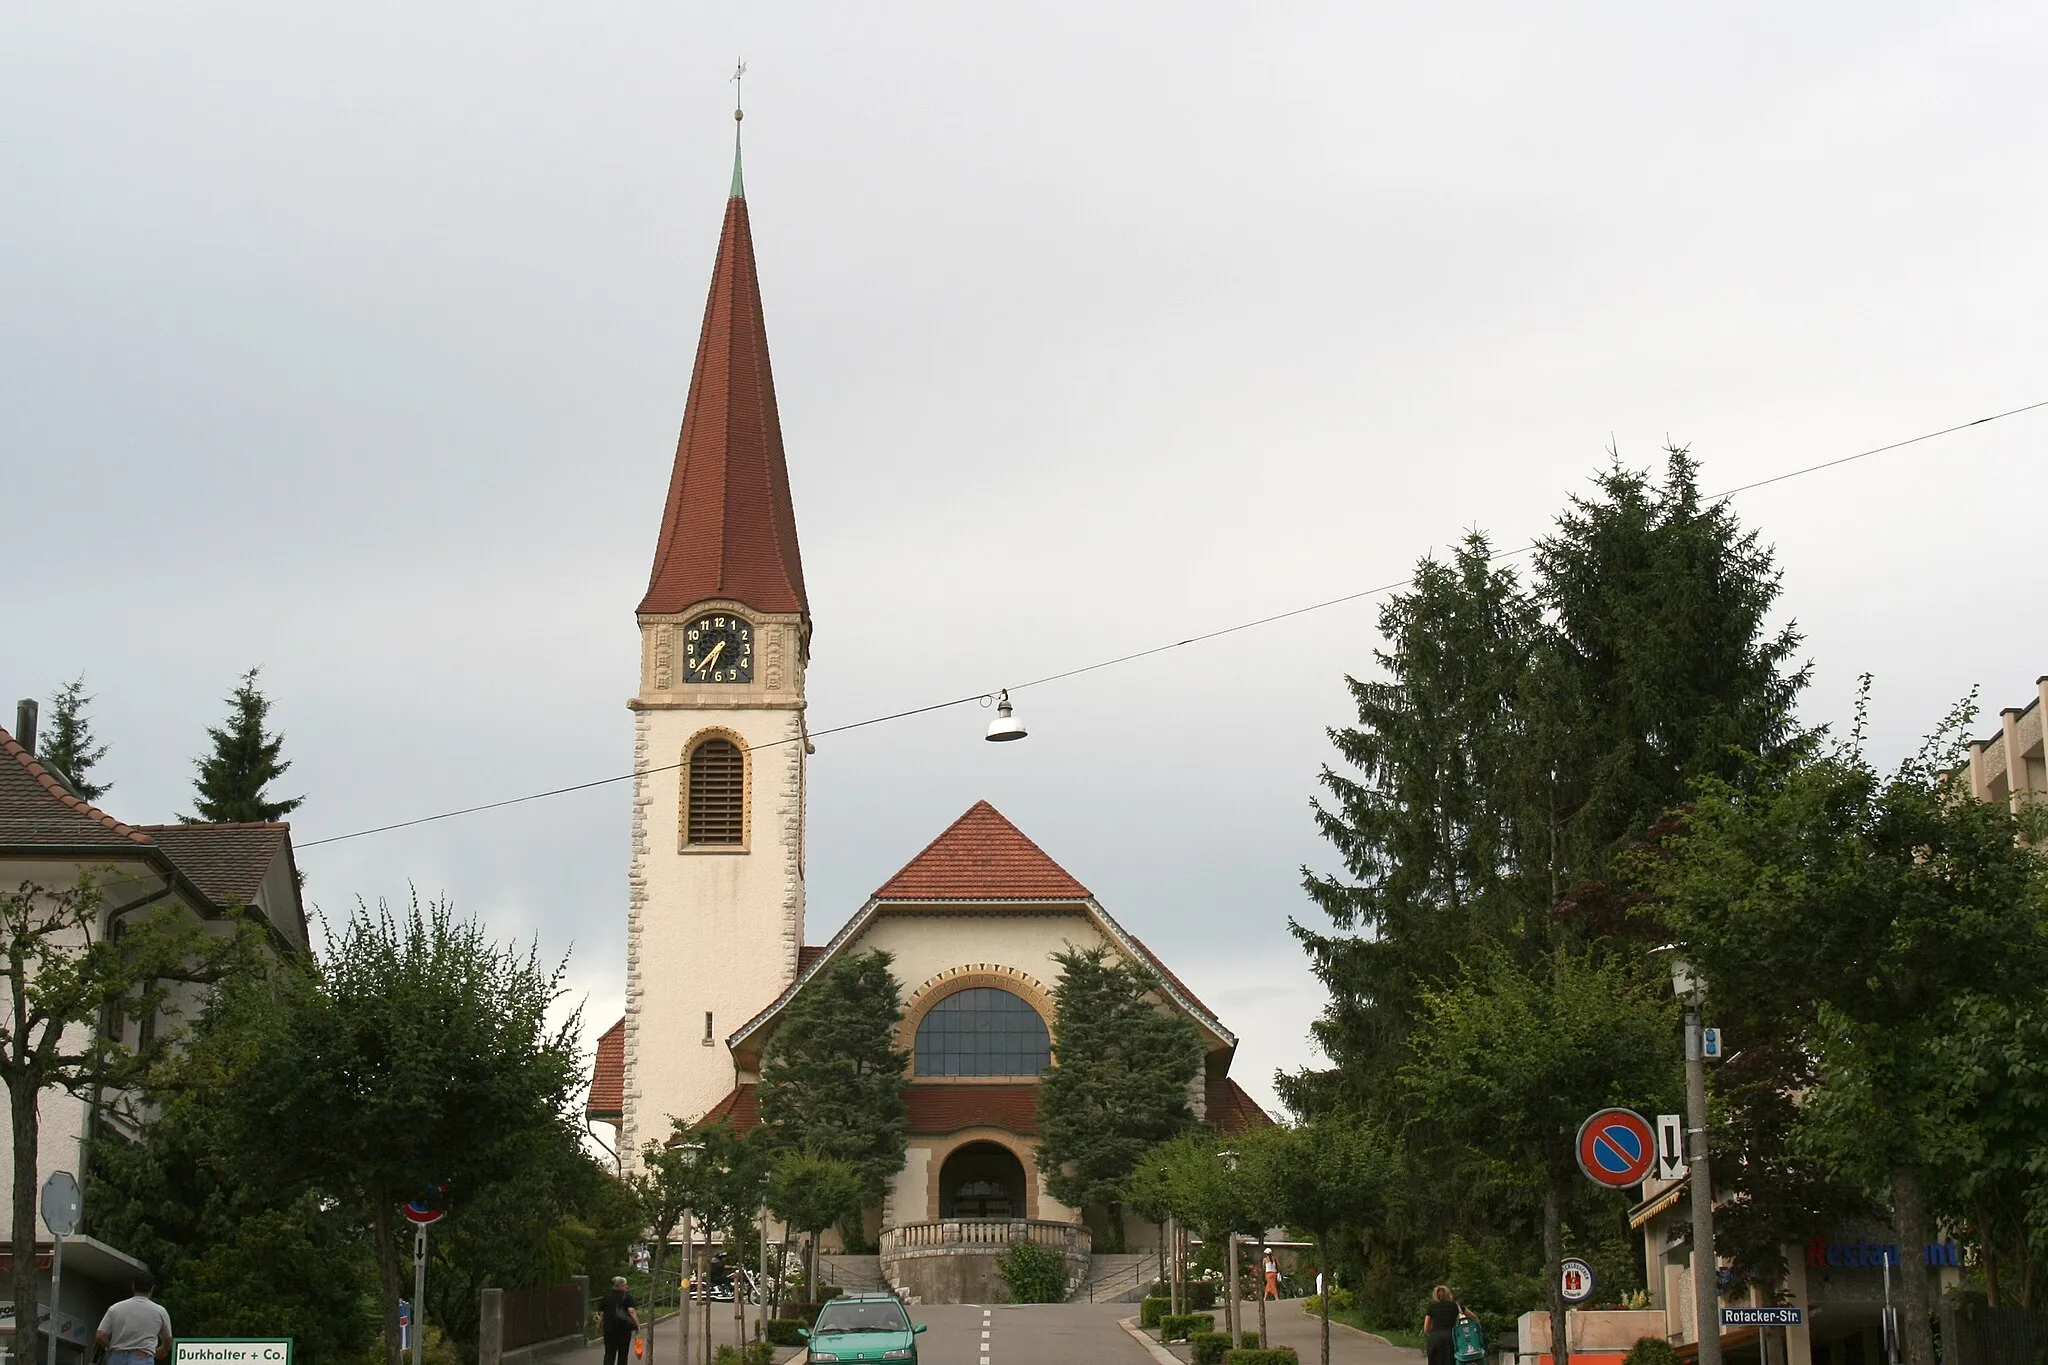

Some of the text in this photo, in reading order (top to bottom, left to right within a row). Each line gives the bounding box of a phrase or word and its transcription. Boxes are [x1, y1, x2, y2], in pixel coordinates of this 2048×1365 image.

[701, 620, 709, 630] 11
[715, 618, 725, 628] 12
[688, 630, 699, 640] 10
[741, 630, 748, 640] 2
[687, 644, 694, 654] 9
[744, 644, 750, 654] 3
[690, 658, 696, 668] 8
[741, 658, 748, 668] 4
[701, 670, 707, 680] 7
[715, 671, 722, 681] 6
[730, 669, 737, 680] 5
[1808, 1236, 1962, 1267] Restaunt
[1725, 1310, 1799, 1322] Rotacker-Str.
[179, 1348, 247, 1360] Burkhalter
[263, 1348, 285, 1360] Co.
